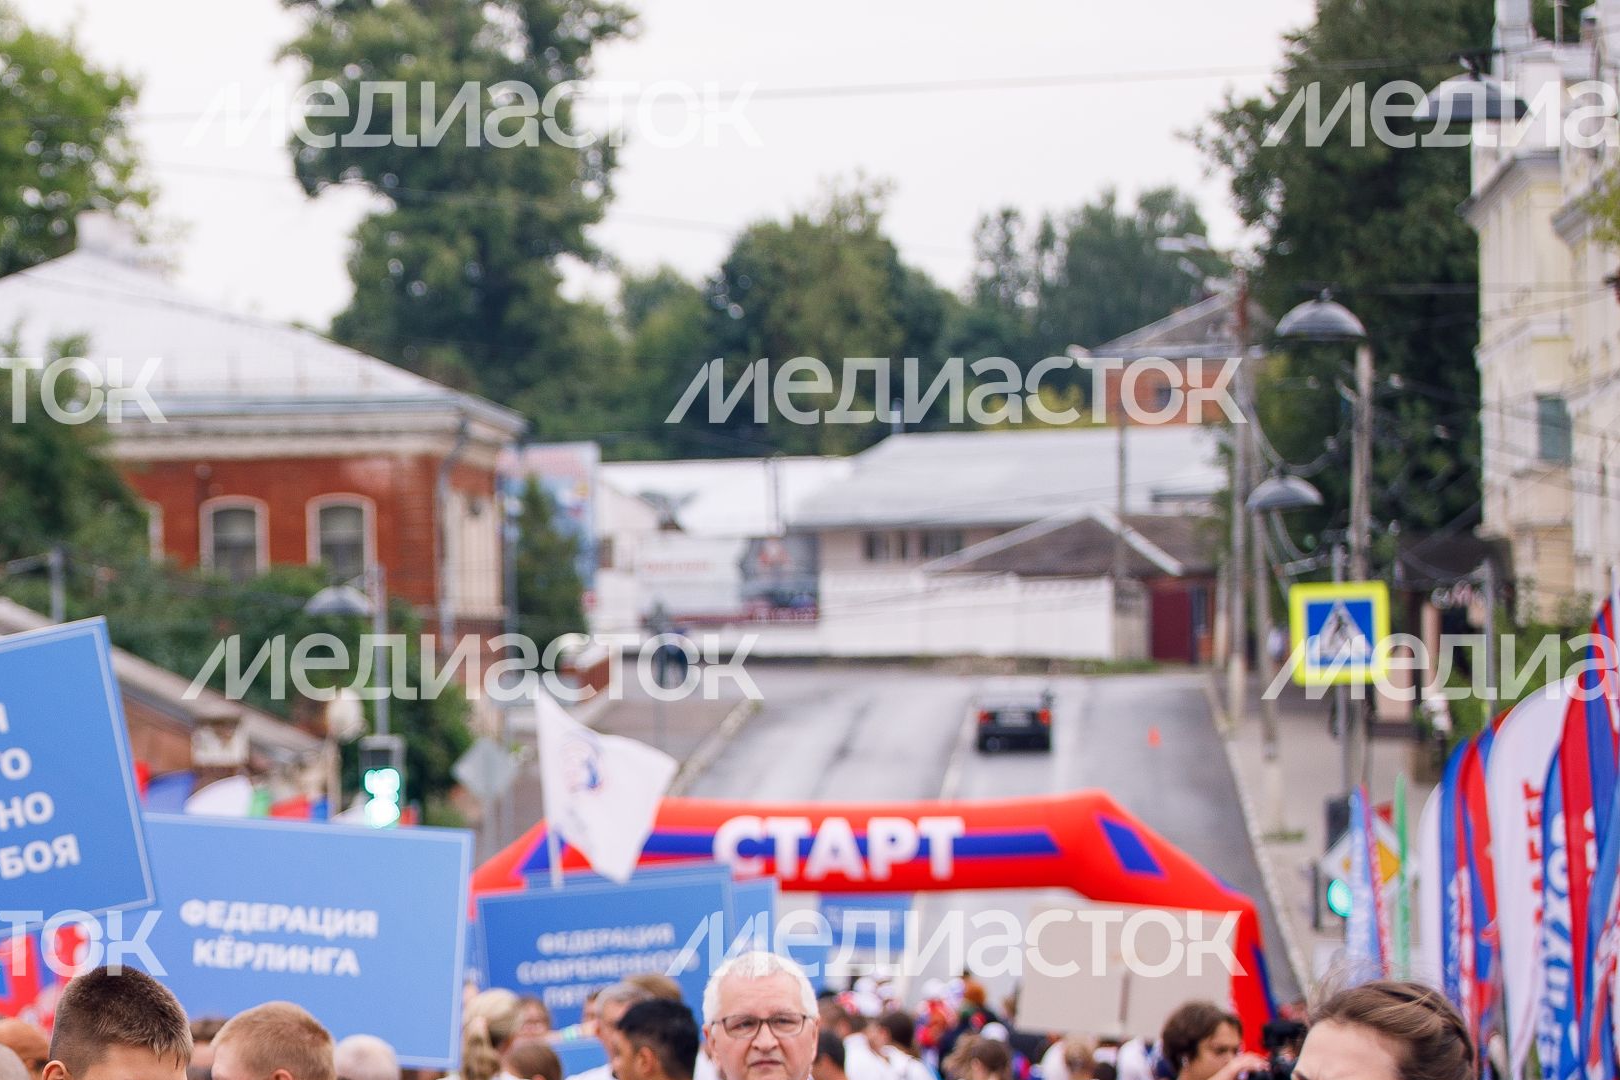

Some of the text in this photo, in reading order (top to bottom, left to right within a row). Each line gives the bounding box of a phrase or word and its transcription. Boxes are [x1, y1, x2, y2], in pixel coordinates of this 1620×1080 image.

[712, 816, 965, 881] СТАРТ
[181, 899, 379, 941] ФЕДЕРАЦИЯ
[193, 935, 361, 977] КЁРЛИНГА
